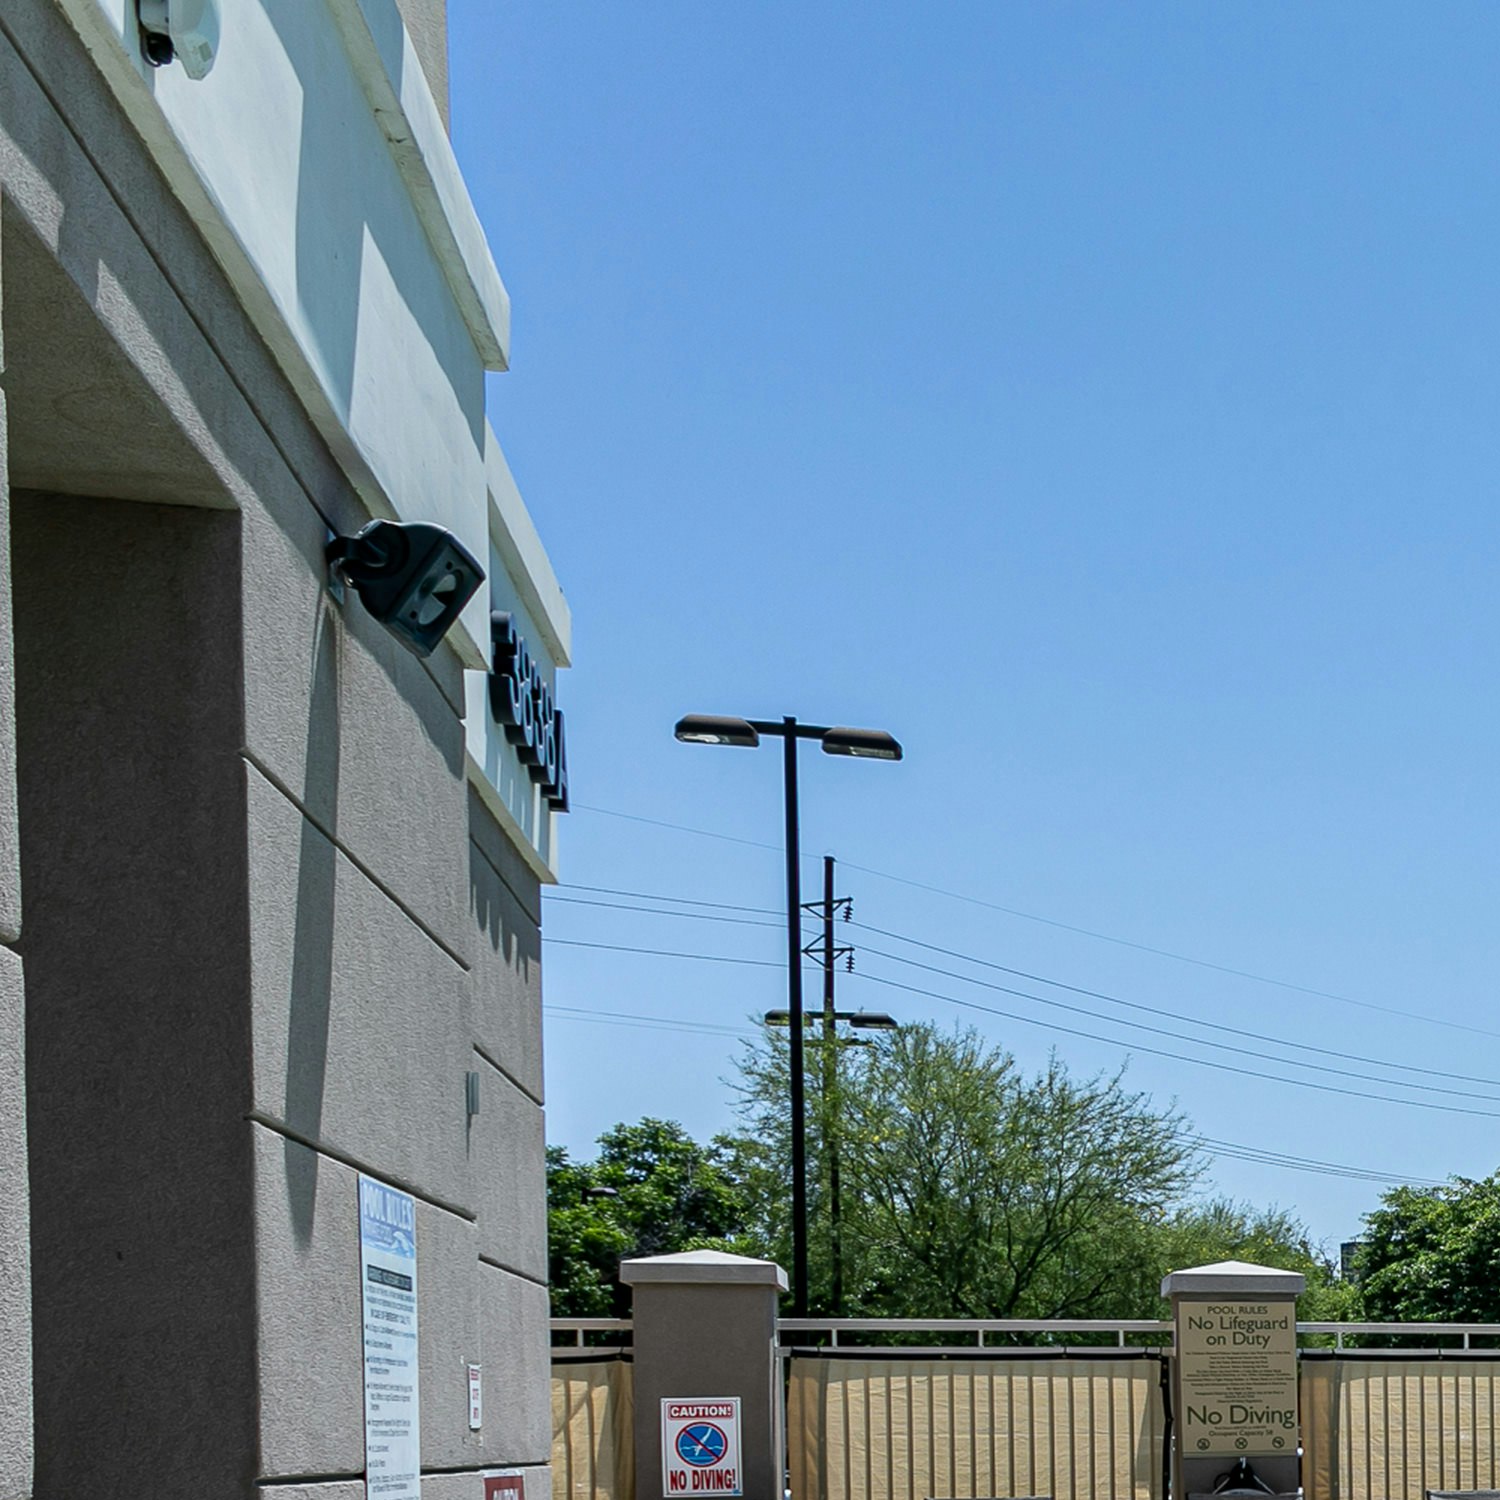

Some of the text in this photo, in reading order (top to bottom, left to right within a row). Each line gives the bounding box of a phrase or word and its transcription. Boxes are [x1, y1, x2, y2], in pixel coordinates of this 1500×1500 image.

[1207, 1305, 1268, 1315] POOL RULES
[1188, 1316, 1288, 1334] No Lifeguard
[1206, 1331, 1271, 1349] on Duty
[670, 1405, 732, 1417] CAUTION!
[1187, 1404, 1295, 1429] No Diving
[669, 1468, 736, 1490] NO DIVING!
